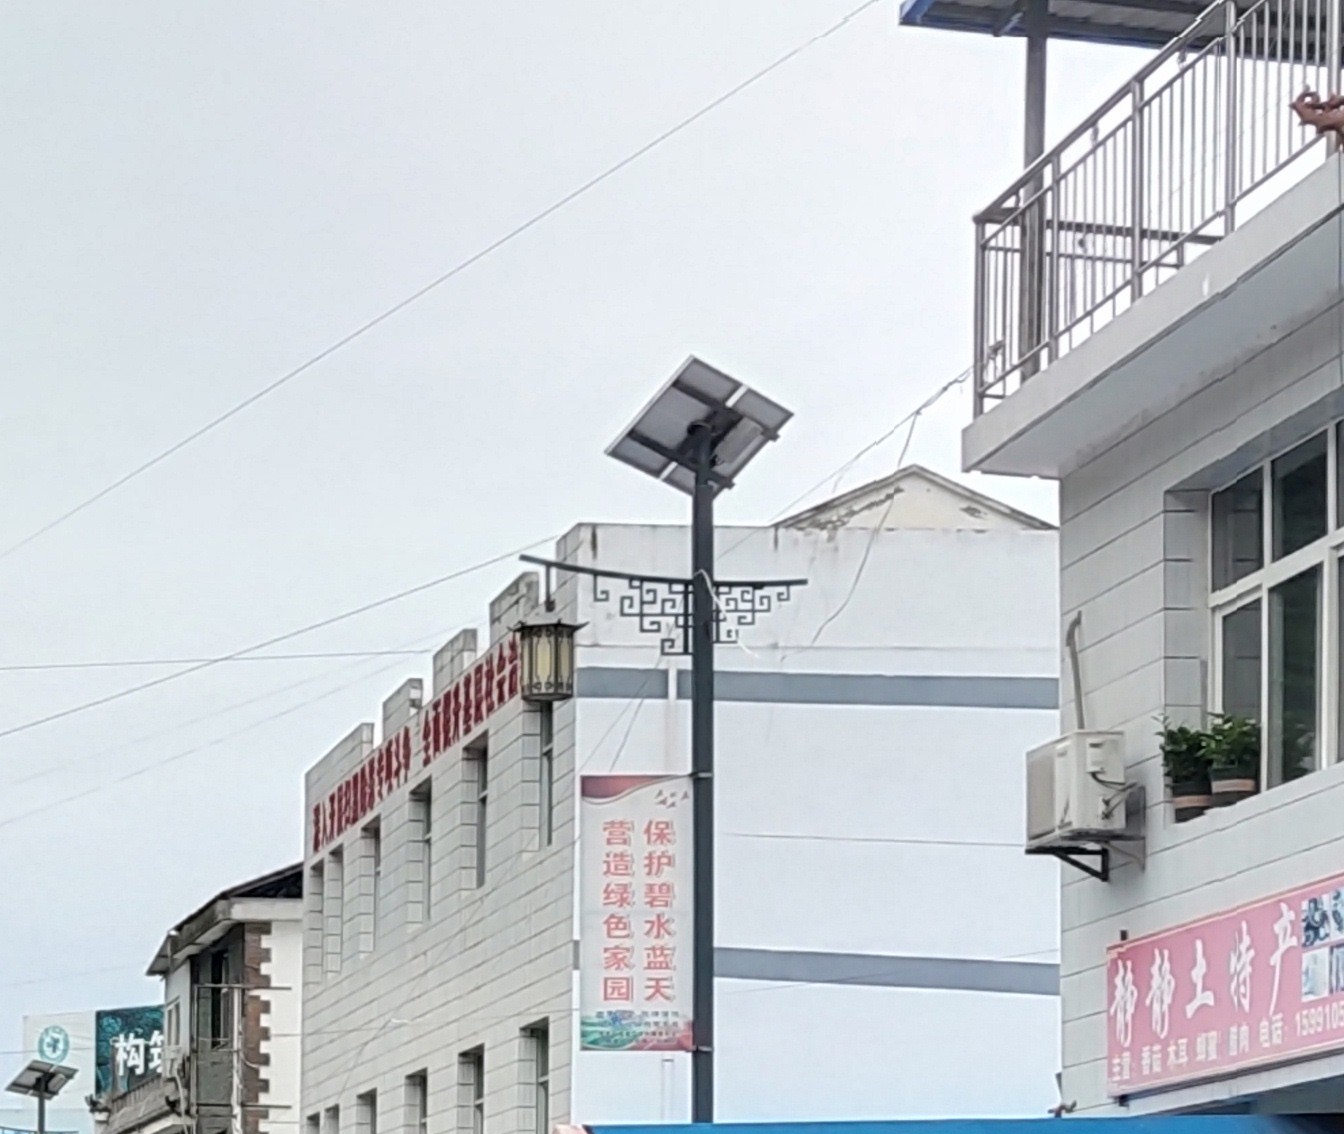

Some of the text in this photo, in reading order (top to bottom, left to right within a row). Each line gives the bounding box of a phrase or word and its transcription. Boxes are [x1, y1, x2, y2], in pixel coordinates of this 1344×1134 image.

[602, 819, 635, 1001] 营造绿色家园
[643, 819, 676, 1001] 保护碧水蓝天
